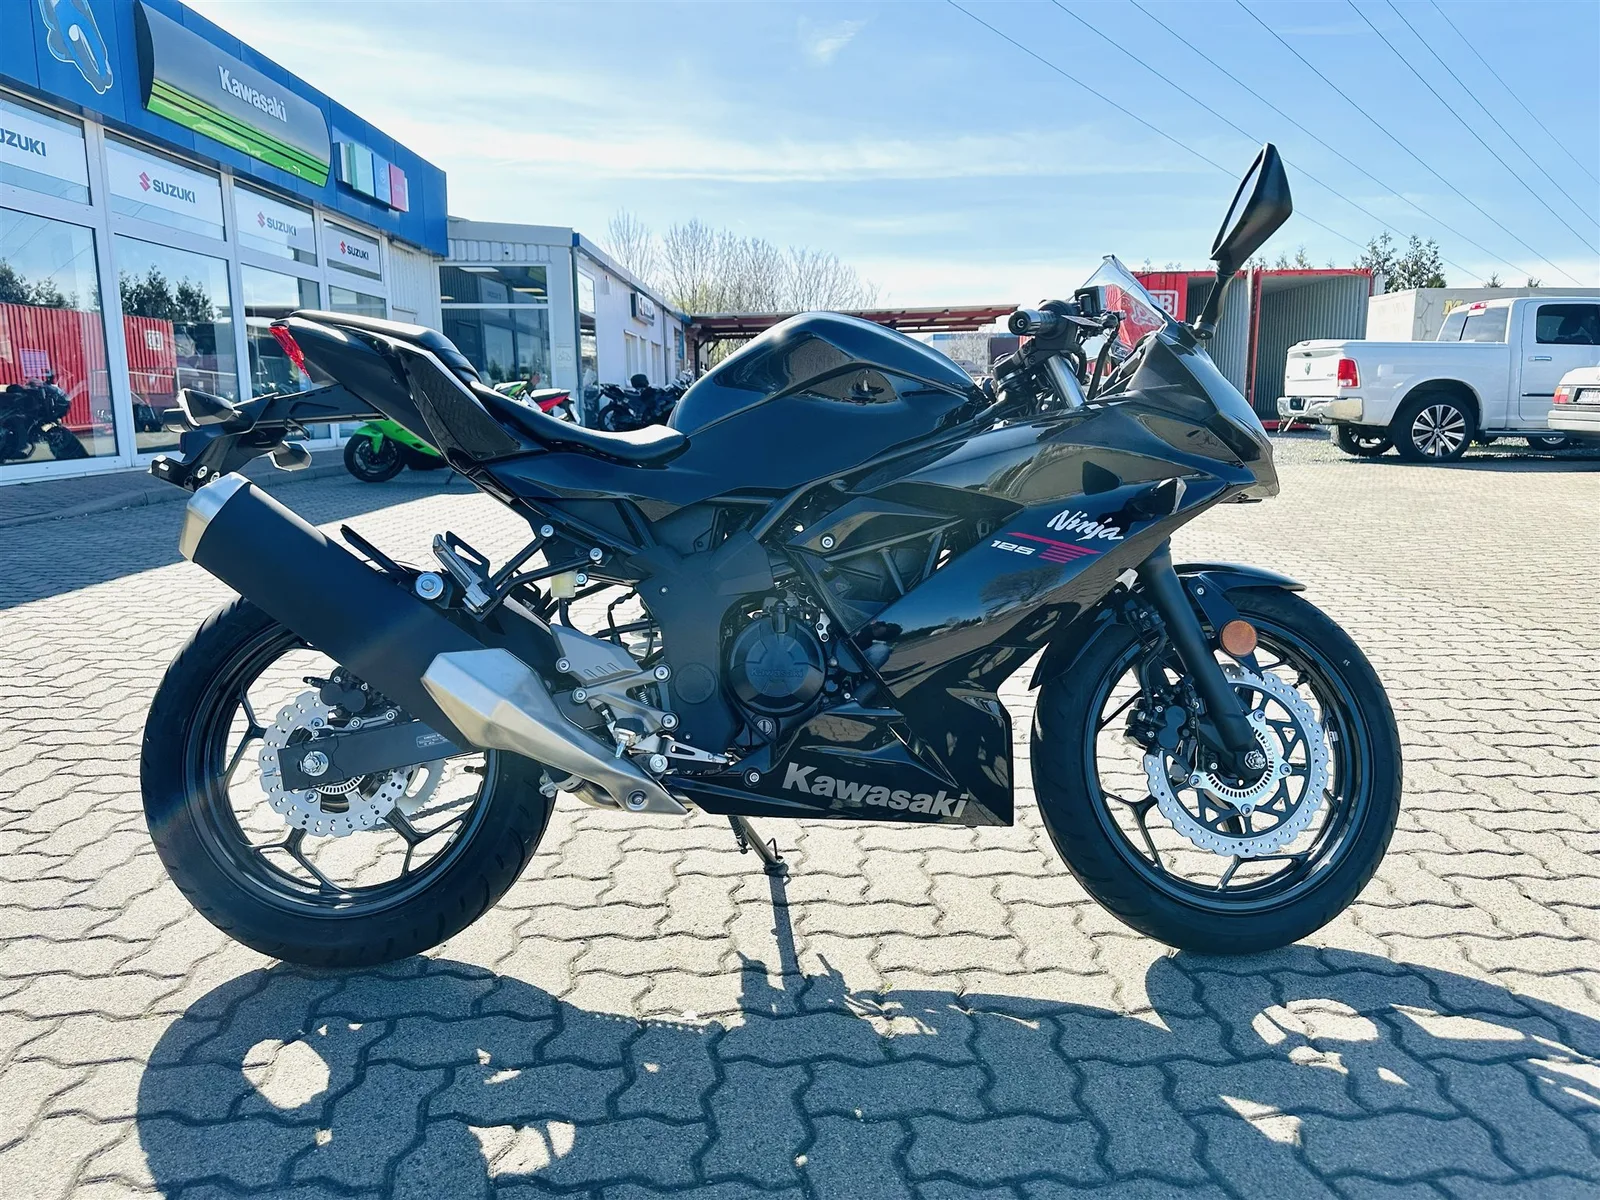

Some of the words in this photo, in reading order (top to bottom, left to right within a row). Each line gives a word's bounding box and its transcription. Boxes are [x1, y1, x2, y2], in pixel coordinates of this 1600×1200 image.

[218, 65, 287, 122] Kawasaki
[152, 179, 196, 203] SUZUKI
[266, 217, 297, 236] SUZUKI
[346, 245, 369, 260] SUZUKI
[1046, 509, 1124, 541] Ninja
[990, 540, 1036, 555] 125
[751, 667, 804, 678] Kawasaki
[782, 762, 969, 818] Kawasaki
